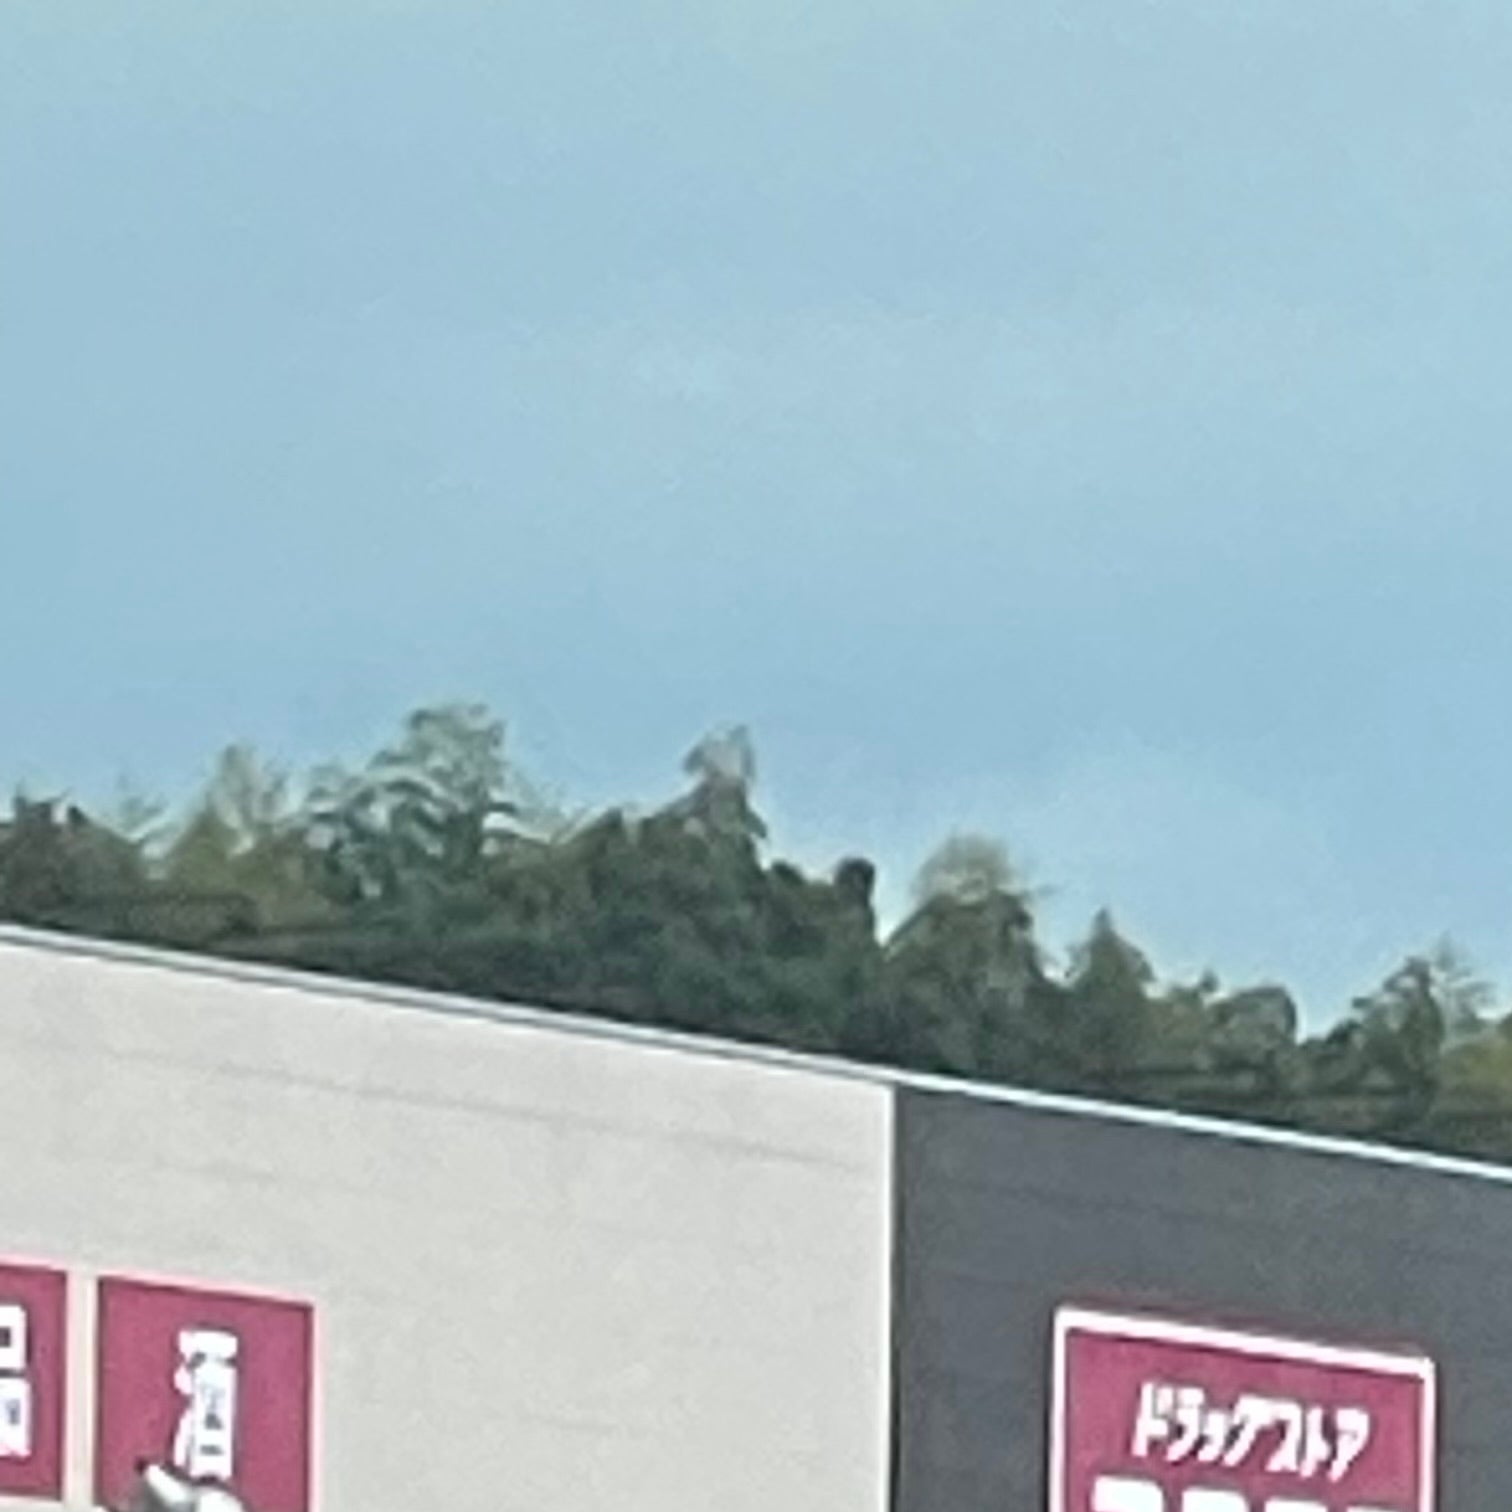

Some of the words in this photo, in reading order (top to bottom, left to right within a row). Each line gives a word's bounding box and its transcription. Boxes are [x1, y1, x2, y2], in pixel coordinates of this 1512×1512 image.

[172, 1328, 240, 1481] 酒
[1130, 1381, 1370, 1483] ドラッグストア
